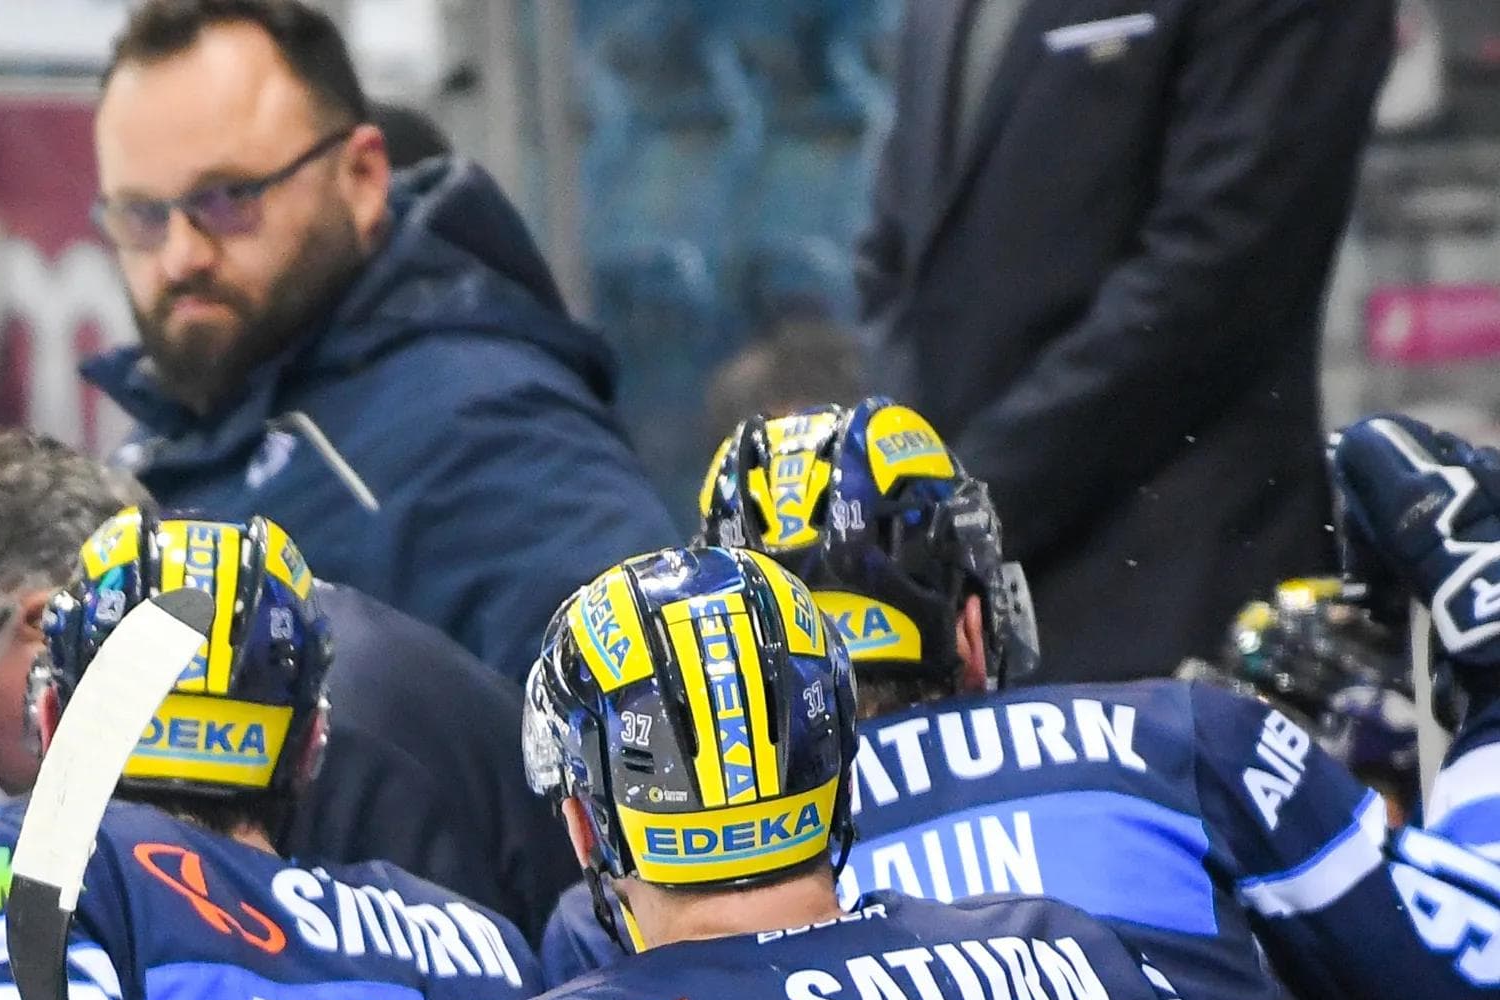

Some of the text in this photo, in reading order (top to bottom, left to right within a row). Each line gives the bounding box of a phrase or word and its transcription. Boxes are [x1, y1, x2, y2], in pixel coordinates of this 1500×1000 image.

[832, 500, 865, 531] 91
[688, 598, 757, 800] EDEKA
[620, 711, 653, 746] 37
[644, 802, 821, 858] EDEKA
